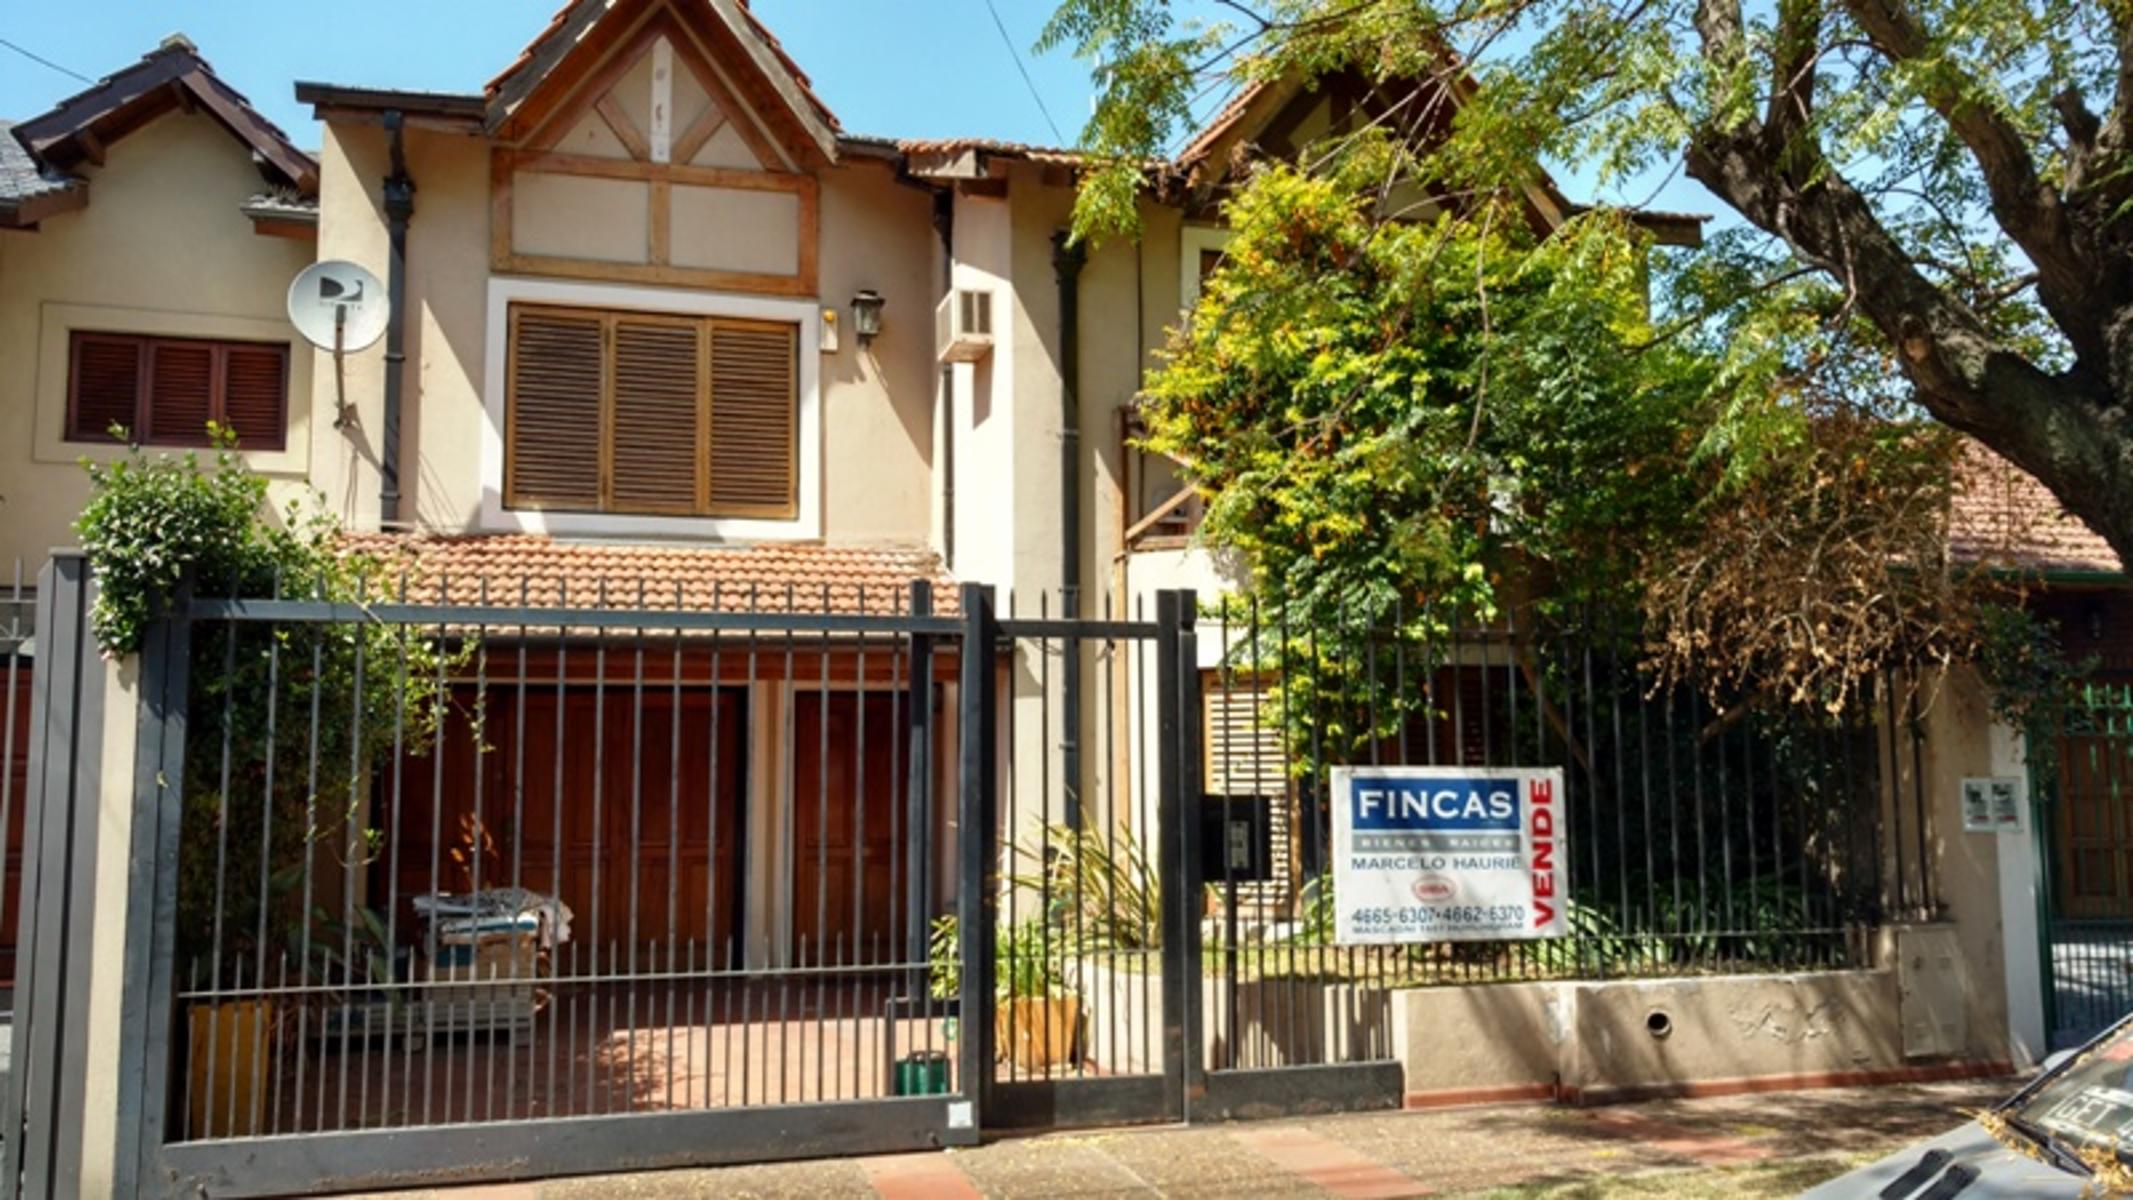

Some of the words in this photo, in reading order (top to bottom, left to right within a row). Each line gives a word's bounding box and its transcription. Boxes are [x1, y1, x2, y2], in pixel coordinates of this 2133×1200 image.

[1359, 790, 1513, 819] FINCAS
[1361, 838, 1431, 848] BIENES
[1530, 778, 1555, 928] VENDE
[1351, 856, 1446, 870] MARCELO
